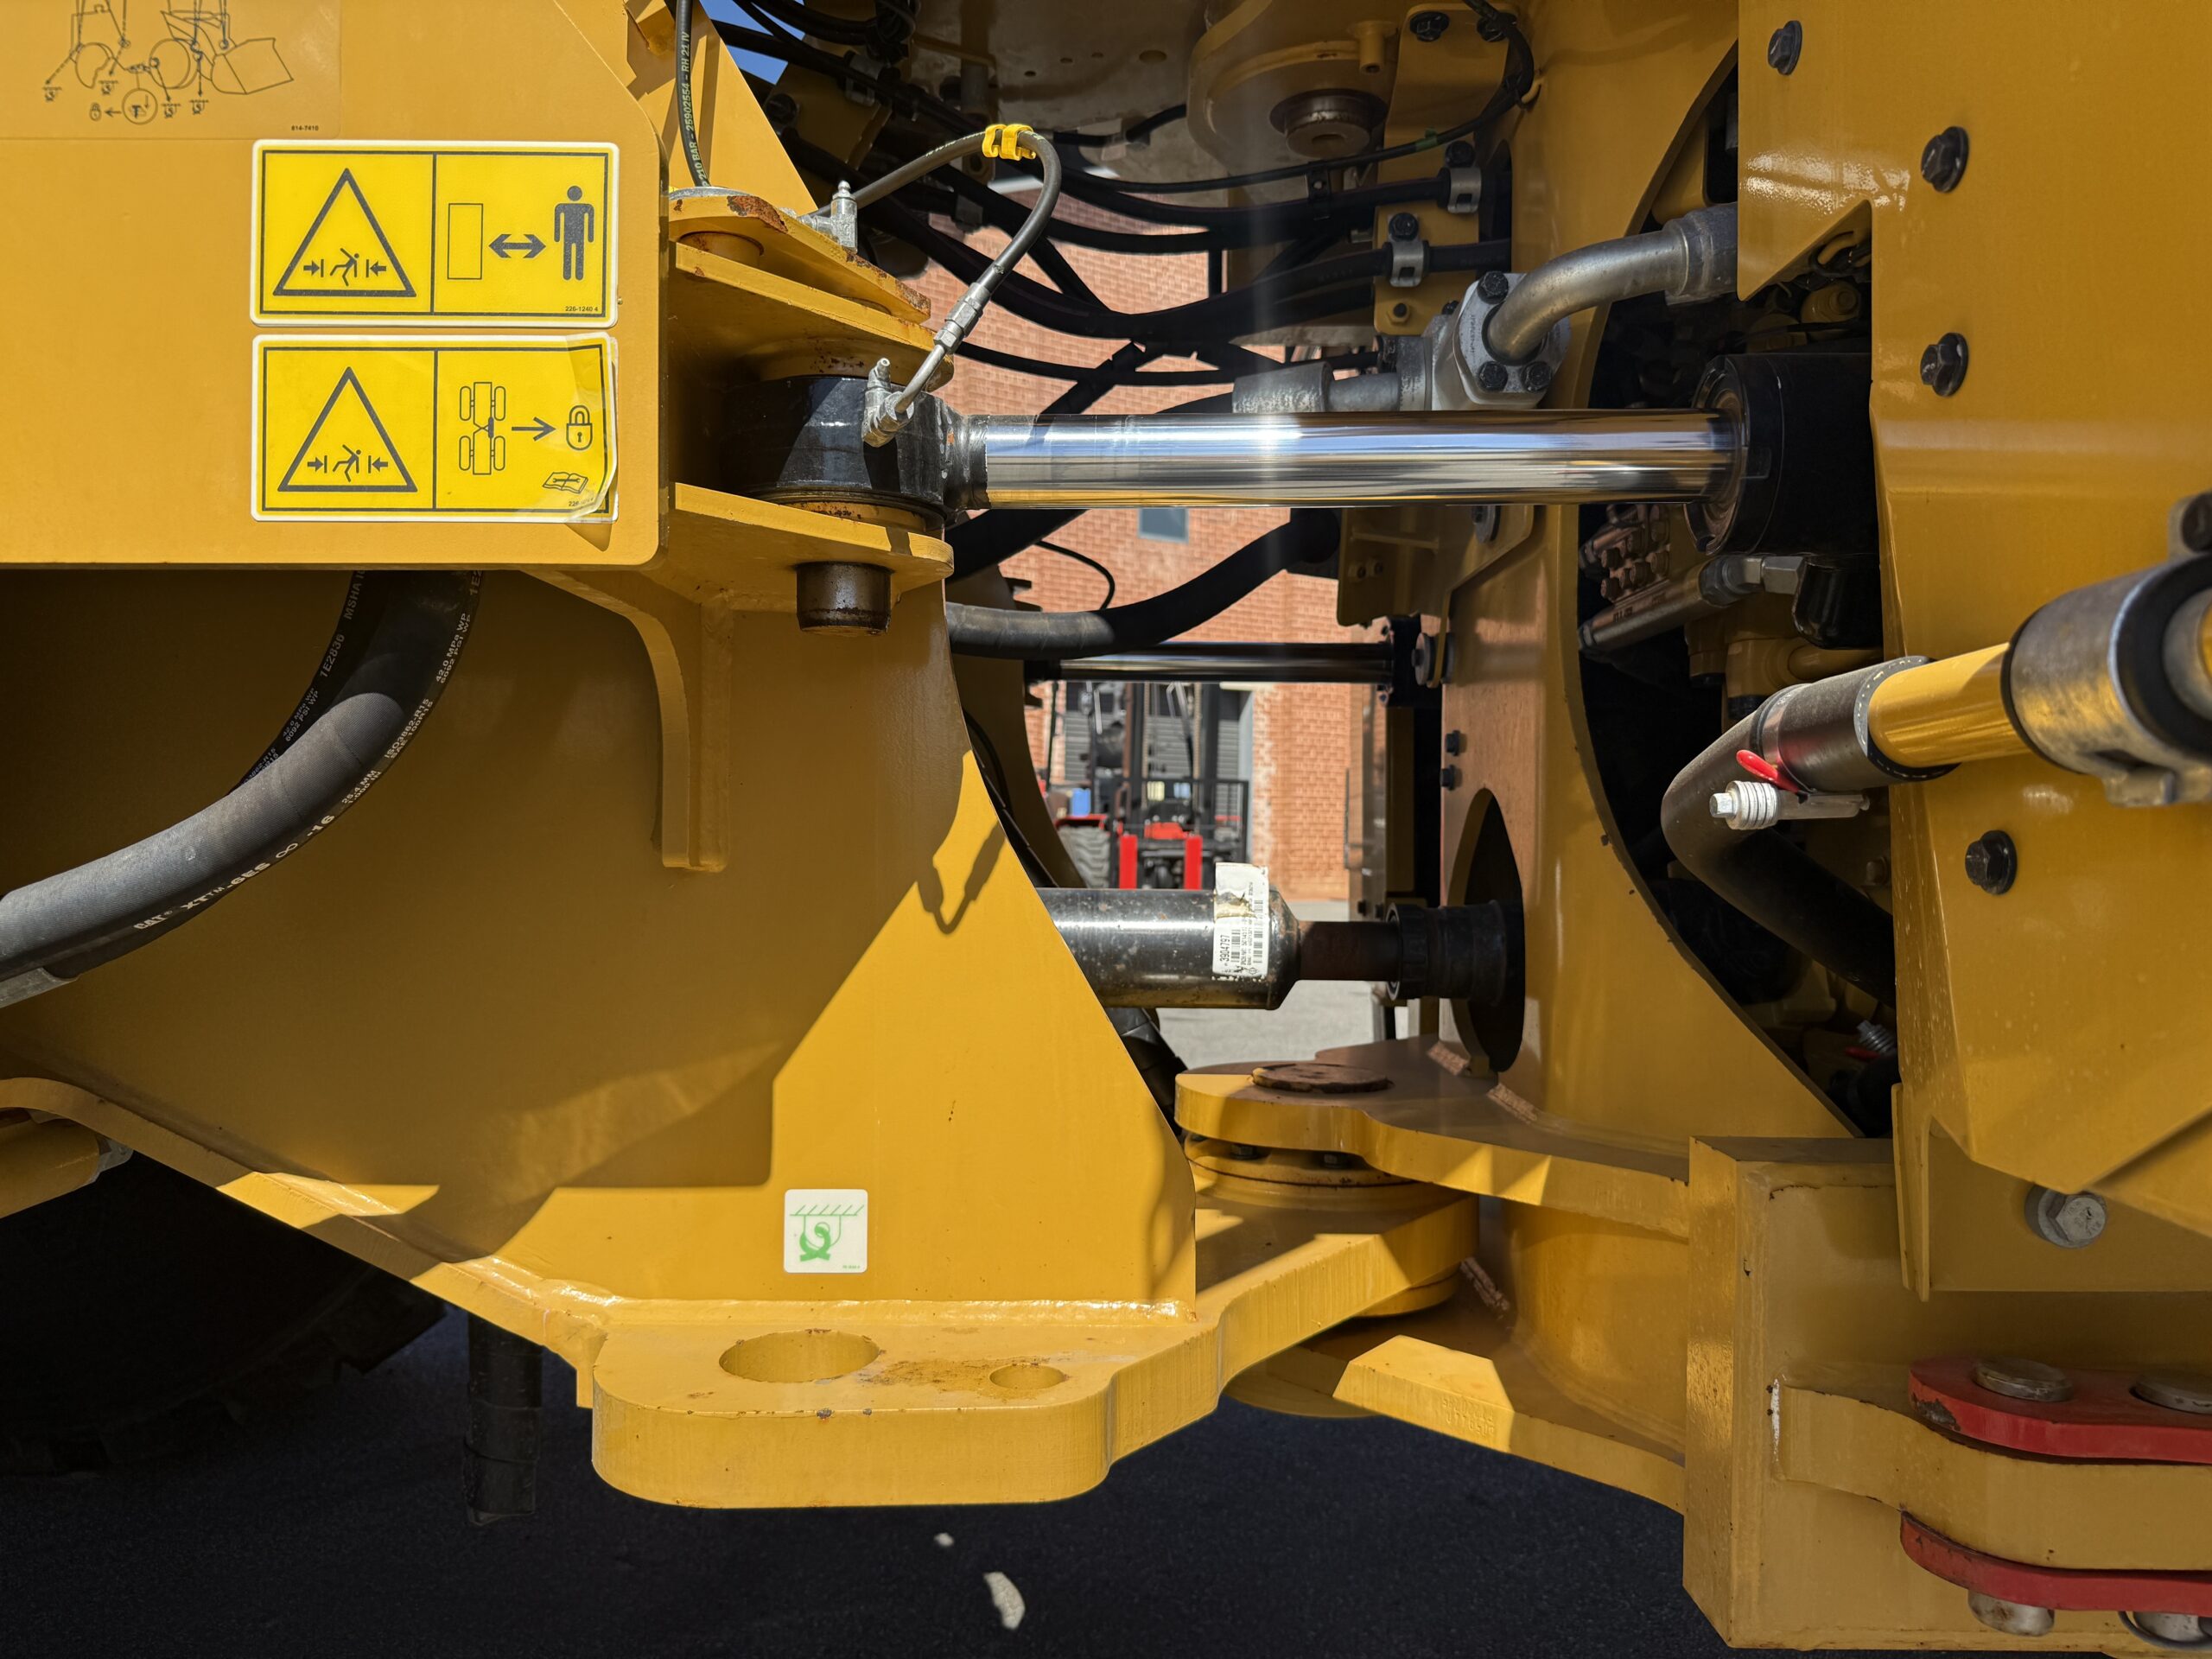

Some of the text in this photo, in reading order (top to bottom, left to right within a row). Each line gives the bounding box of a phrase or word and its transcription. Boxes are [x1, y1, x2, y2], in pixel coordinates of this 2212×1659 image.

[681, 32, 690, 41] IV
[681, 44, 690, 57] 21
[680, 59, 690, 73] RH
[681, 83, 694, 131] 25902554
[689, 141, 701, 162] BAR
[694, 162, 709, 183] 210
[320, 633, 345, 677] 1E2836
[343, 582, 362, 620] MSHA
[461, 614, 471, 632] WP
[435, 613, 466, 682] 42.0 MPa WP
[285, 690, 318, 741] 6092 PSI WP
[359, 770, 377, 785] MM
[370, 771, 382, 780] IN
[307, 815, 335, 837] -16
